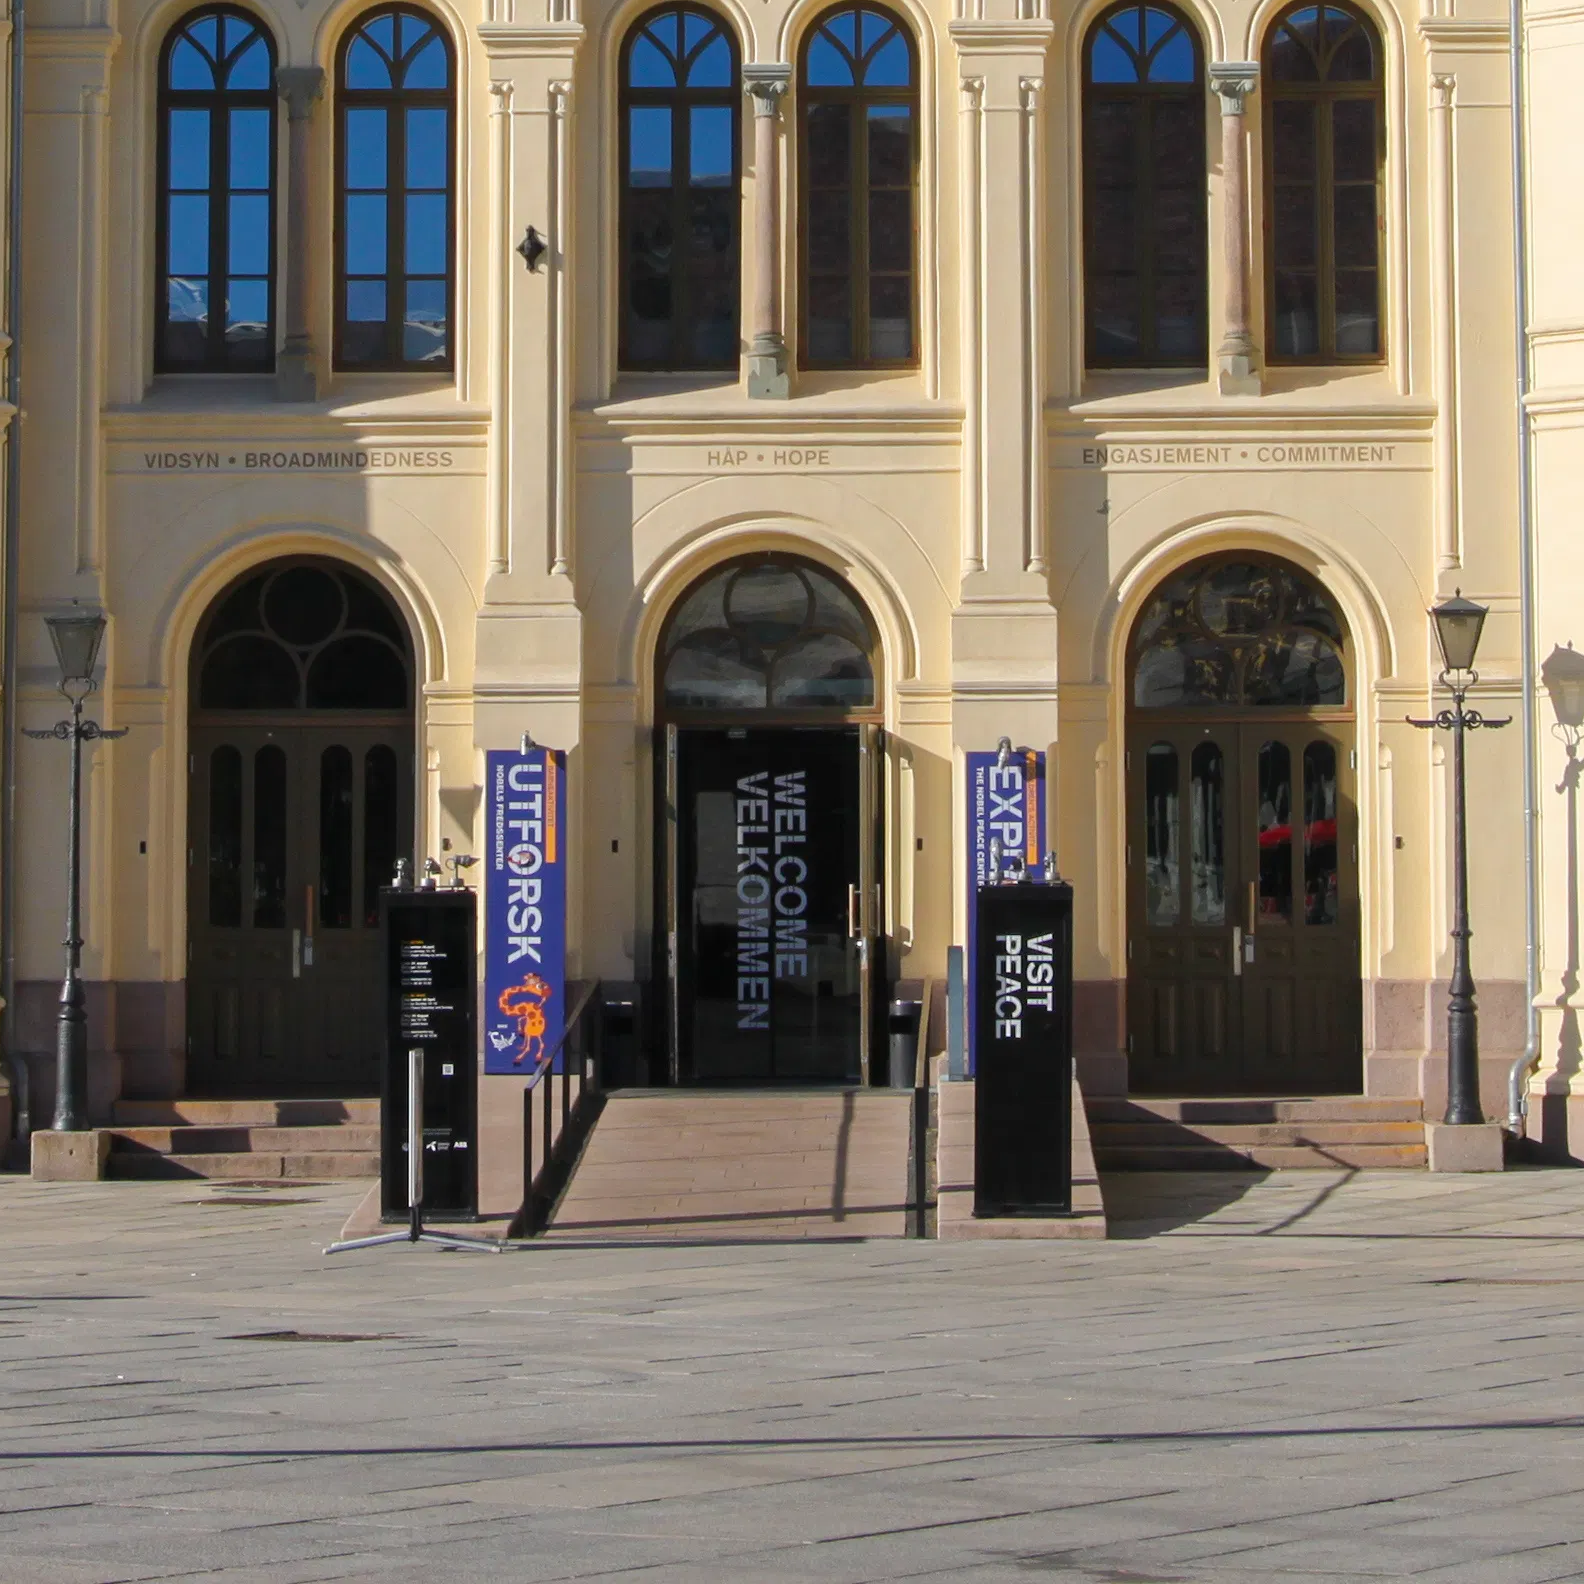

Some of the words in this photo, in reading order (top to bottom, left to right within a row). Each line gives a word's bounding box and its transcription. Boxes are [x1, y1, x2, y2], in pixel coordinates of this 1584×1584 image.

[144, 453, 220, 469] VIDSYN
[245, 452, 453, 468] BROADMINDEDNESS
[707, 447, 749, 466] HÅP
[773, 450, 831, 466] HOPE
[1083, 448, 1232, 465] ENGASJEMENT
[1257, 446, 1395, 463] COMMITMENT
[496, 764, 504, 801] NOBELS
[976, 767, 984, 786] THE
[976, 787, 984, 818] NOBEL
[495, 803, 504, 871] FREDSSENTER
[976, 819, 985, 849] PEACE
[508, 763, 543, 964] UTFORSK
[774, 770, 808, 977] WELCOME
[736, 771, 770, 1029] VELKOMMEN
[995, 935, 1022, 1039] PEACE
[1026, 933, 1053, 1011] VISIT
